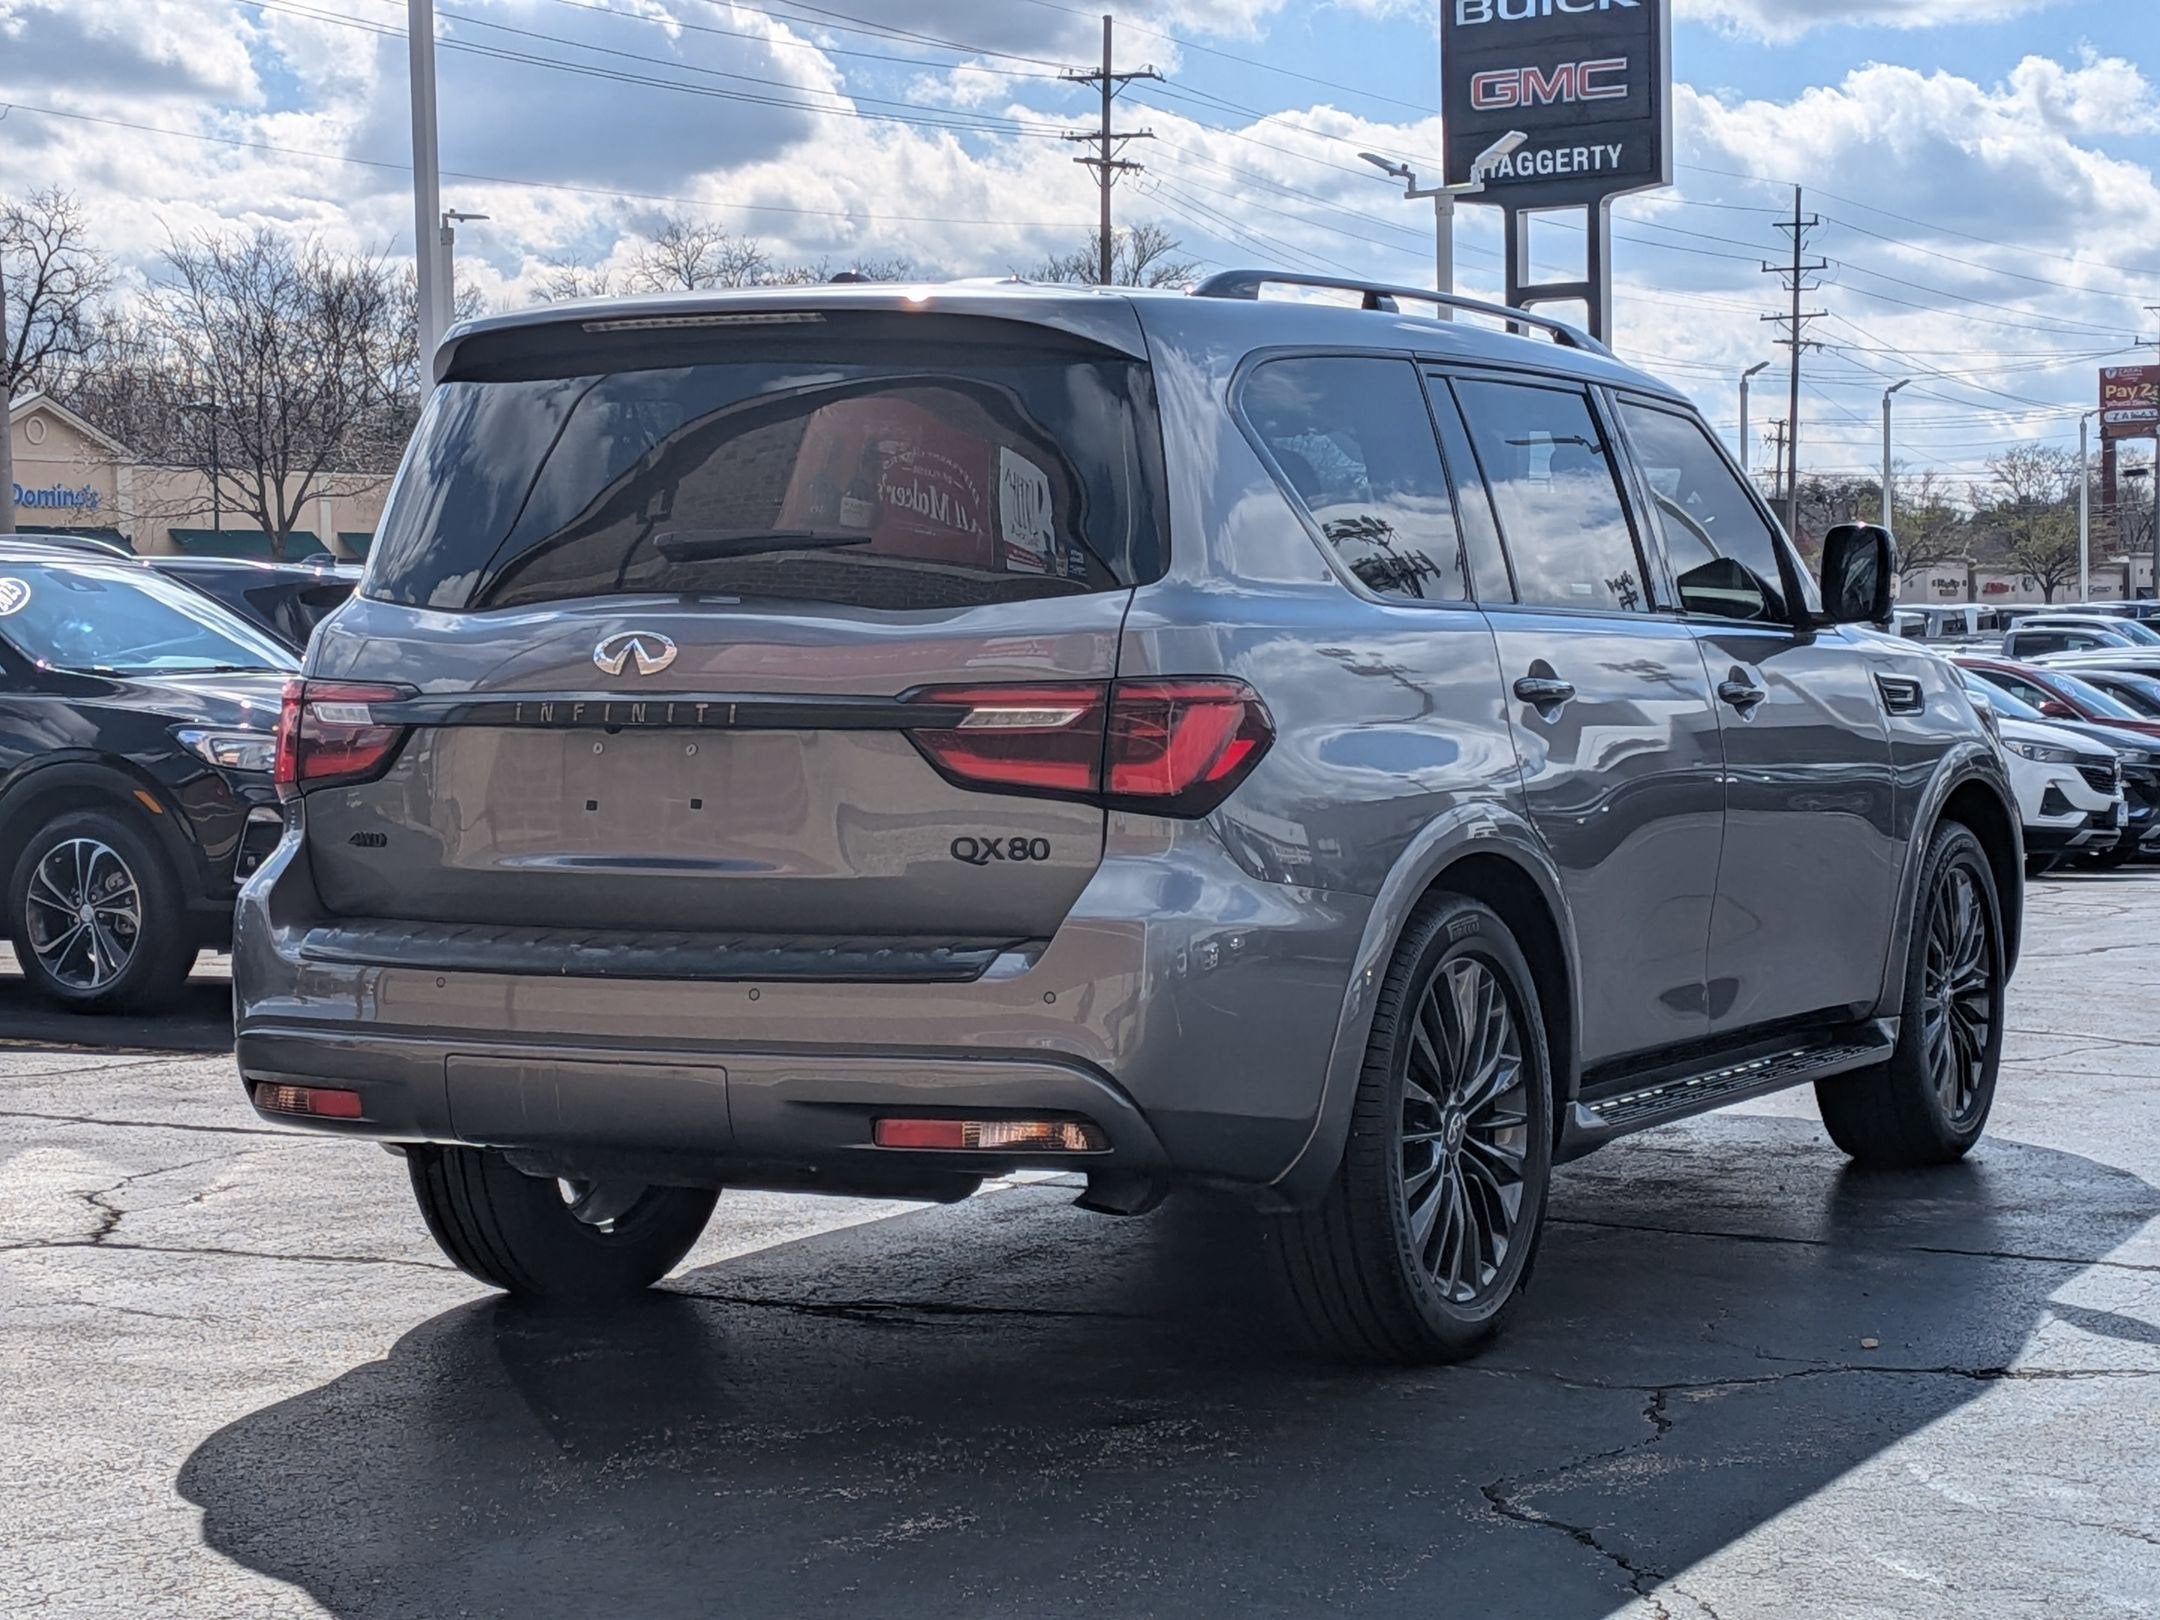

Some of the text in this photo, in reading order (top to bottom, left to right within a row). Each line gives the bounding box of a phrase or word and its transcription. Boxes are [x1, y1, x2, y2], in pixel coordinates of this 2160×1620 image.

[1471, 57, 1627, 110] GMC
[2105, 384, 2138, 400] Pay
[514, 702, 736, 723] INFINITI
[951, 837, 1050, 865] QX80
